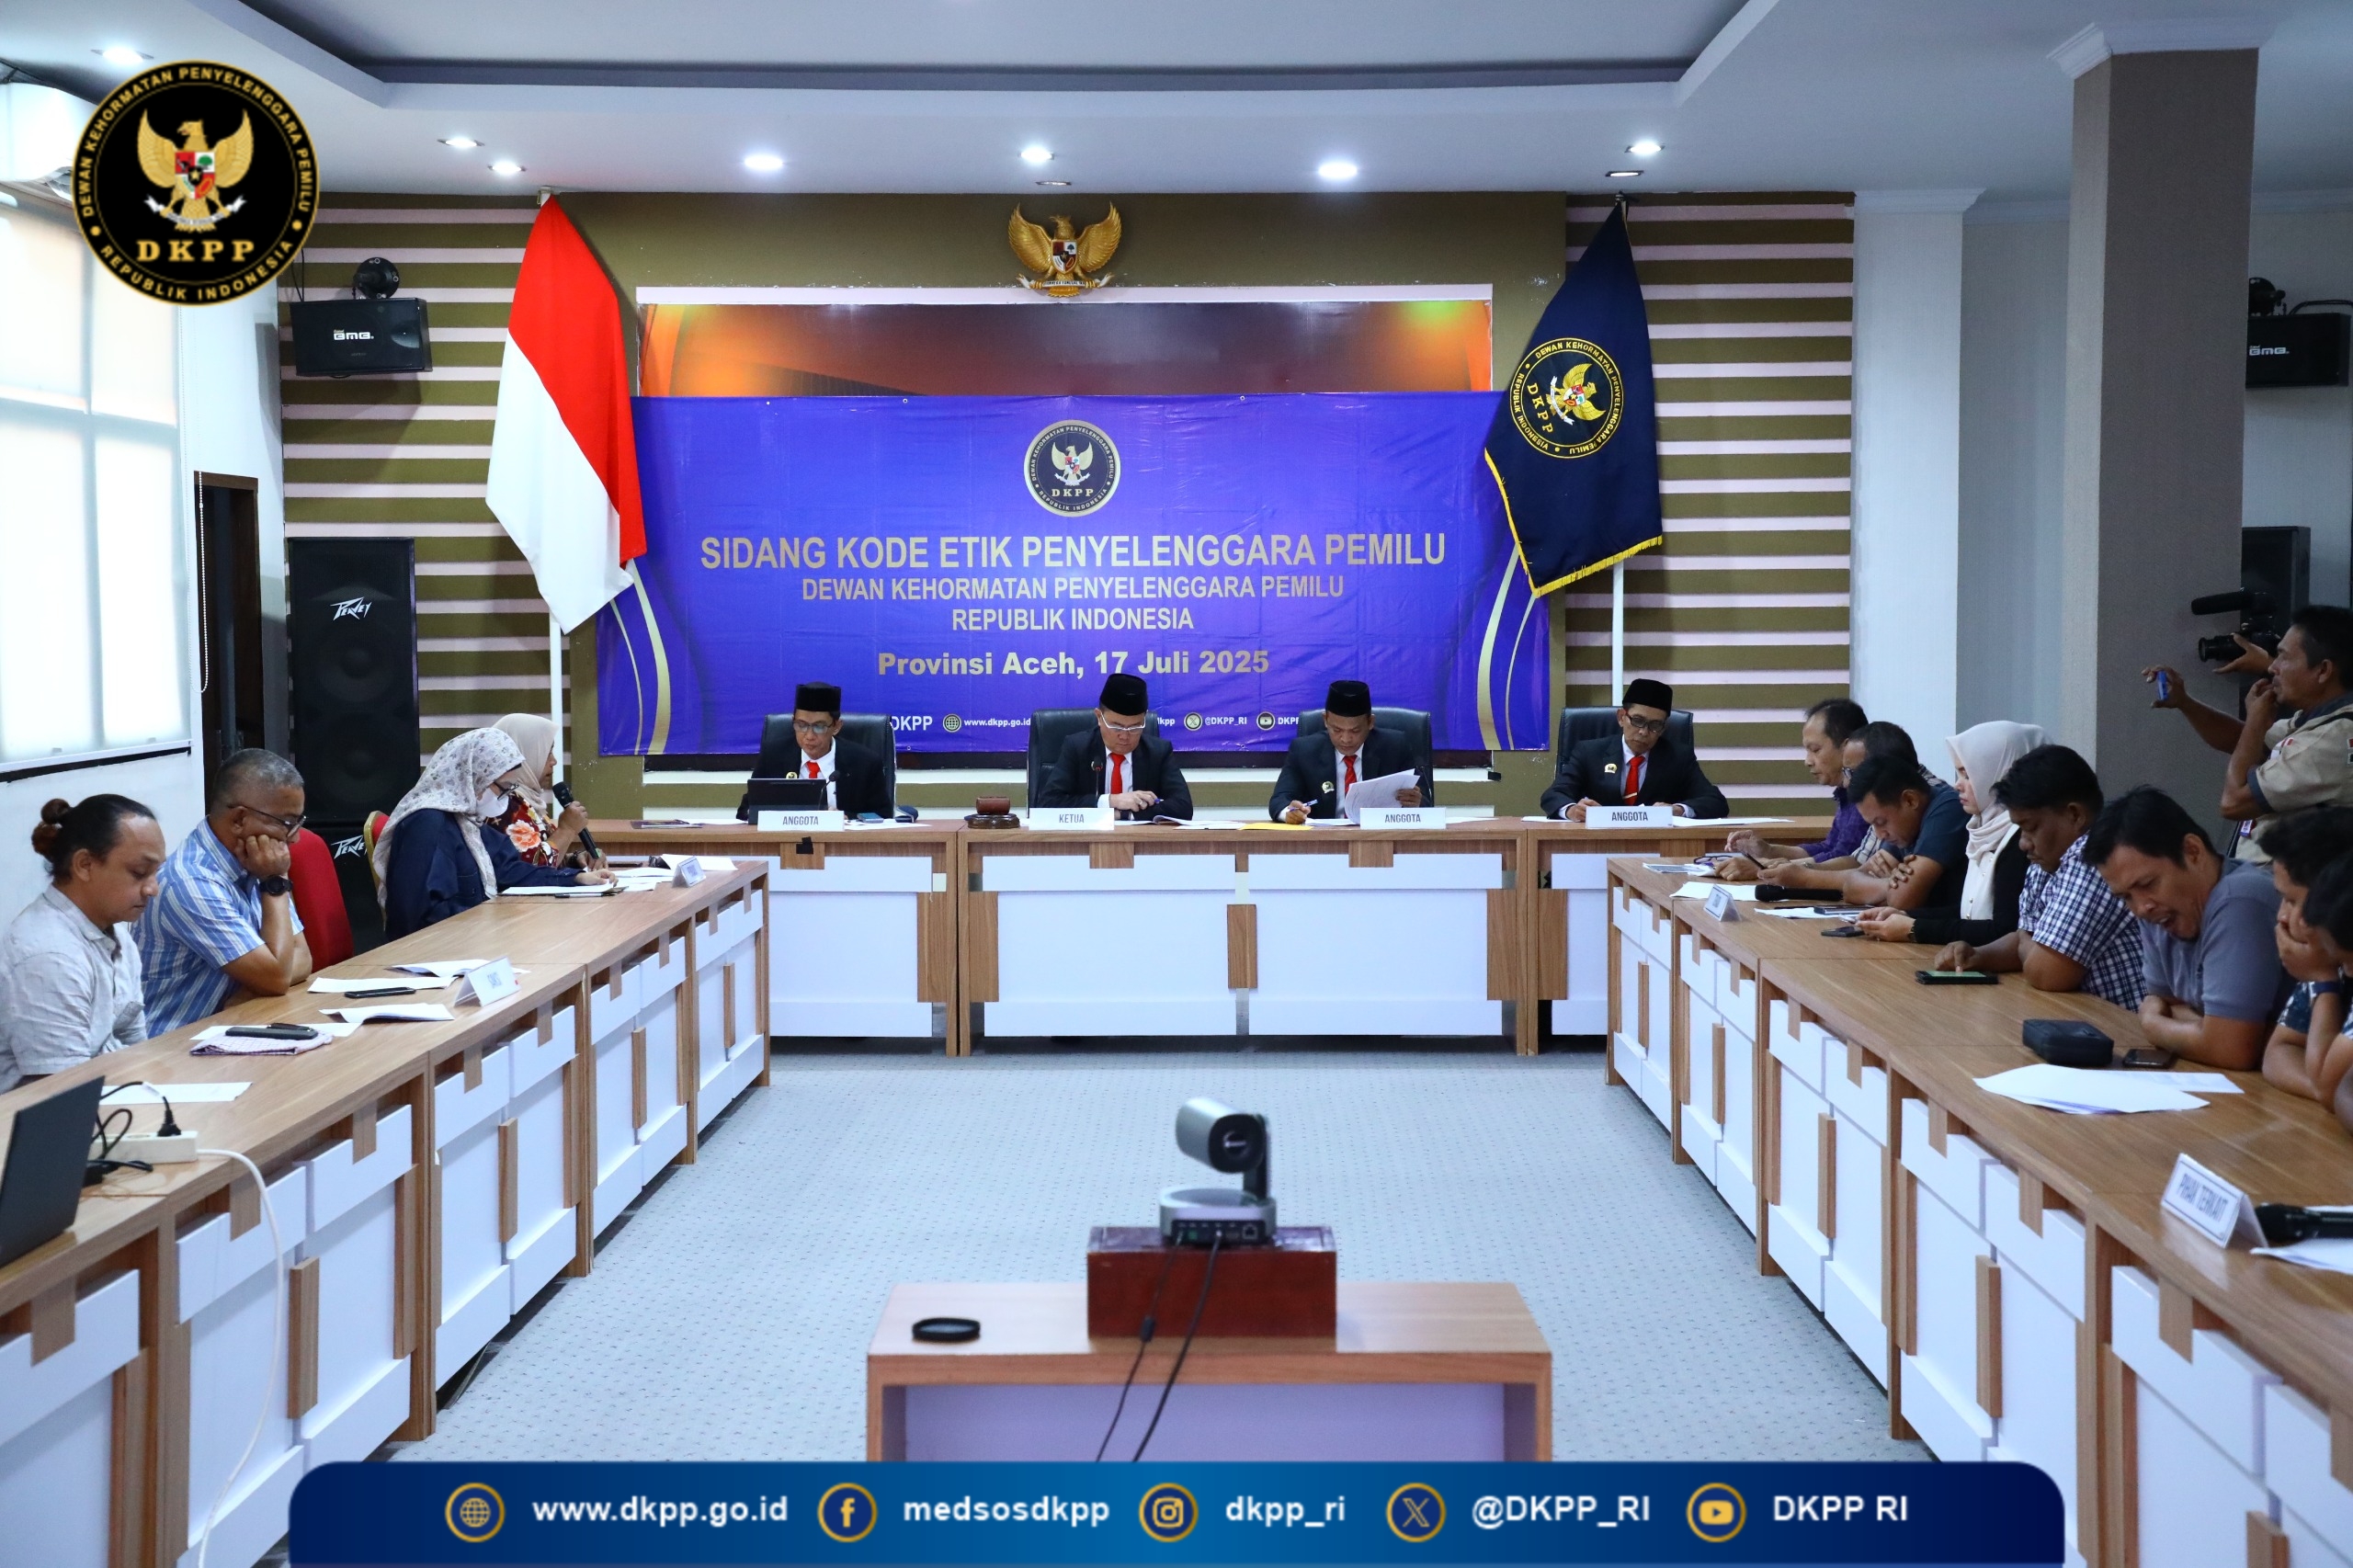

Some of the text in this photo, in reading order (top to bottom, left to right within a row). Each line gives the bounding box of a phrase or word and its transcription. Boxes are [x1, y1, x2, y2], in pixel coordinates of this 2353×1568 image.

[1535, 342, 1563, 359] DEWAN
[1565, 341, 1614, 375] KEHORMATAN
[1513, 372, 1549, 450] REPUBLIK INDONESIA
[1527, 382, 1554, 434] DKPP
[1034, 427, 1064, 458] KEHORMATAN
[1066, 426, 1110, 455] PENYELENGGARA
[1039, 488, 1108, 511] REPUBLIK INDONESIA
[1051, 488, 1094, 497] DKPP
[700, 532, 1446, 569] SIDANG KODE ETIK PENYELENGGARA PEMILU
[802, 574, 1344, 600] DEWAN KEHORMATAN PENYELENGGARA PEMILU
[330, 597, 372, 620] PEAVEY
[952, 607, 1195, 631] REPUBLIK INDONESIA
[878, 650, 1269, 679] Provinsi Aceh, 17 Juli 2025
[964, 717, 1031, 728] www.dkpp.go.id
[1205, 716, 1247, 726] @DKPP_RI
[782, 816, 820, 826] ANGGOTA
[1059, 813, 1086, 824] KETUA
[1384, 813, 1422, 824] ANGGOTA
[1611, 812, 1649, 822] ANGGOTA
[331, 835, 367, 859] PEAVE
